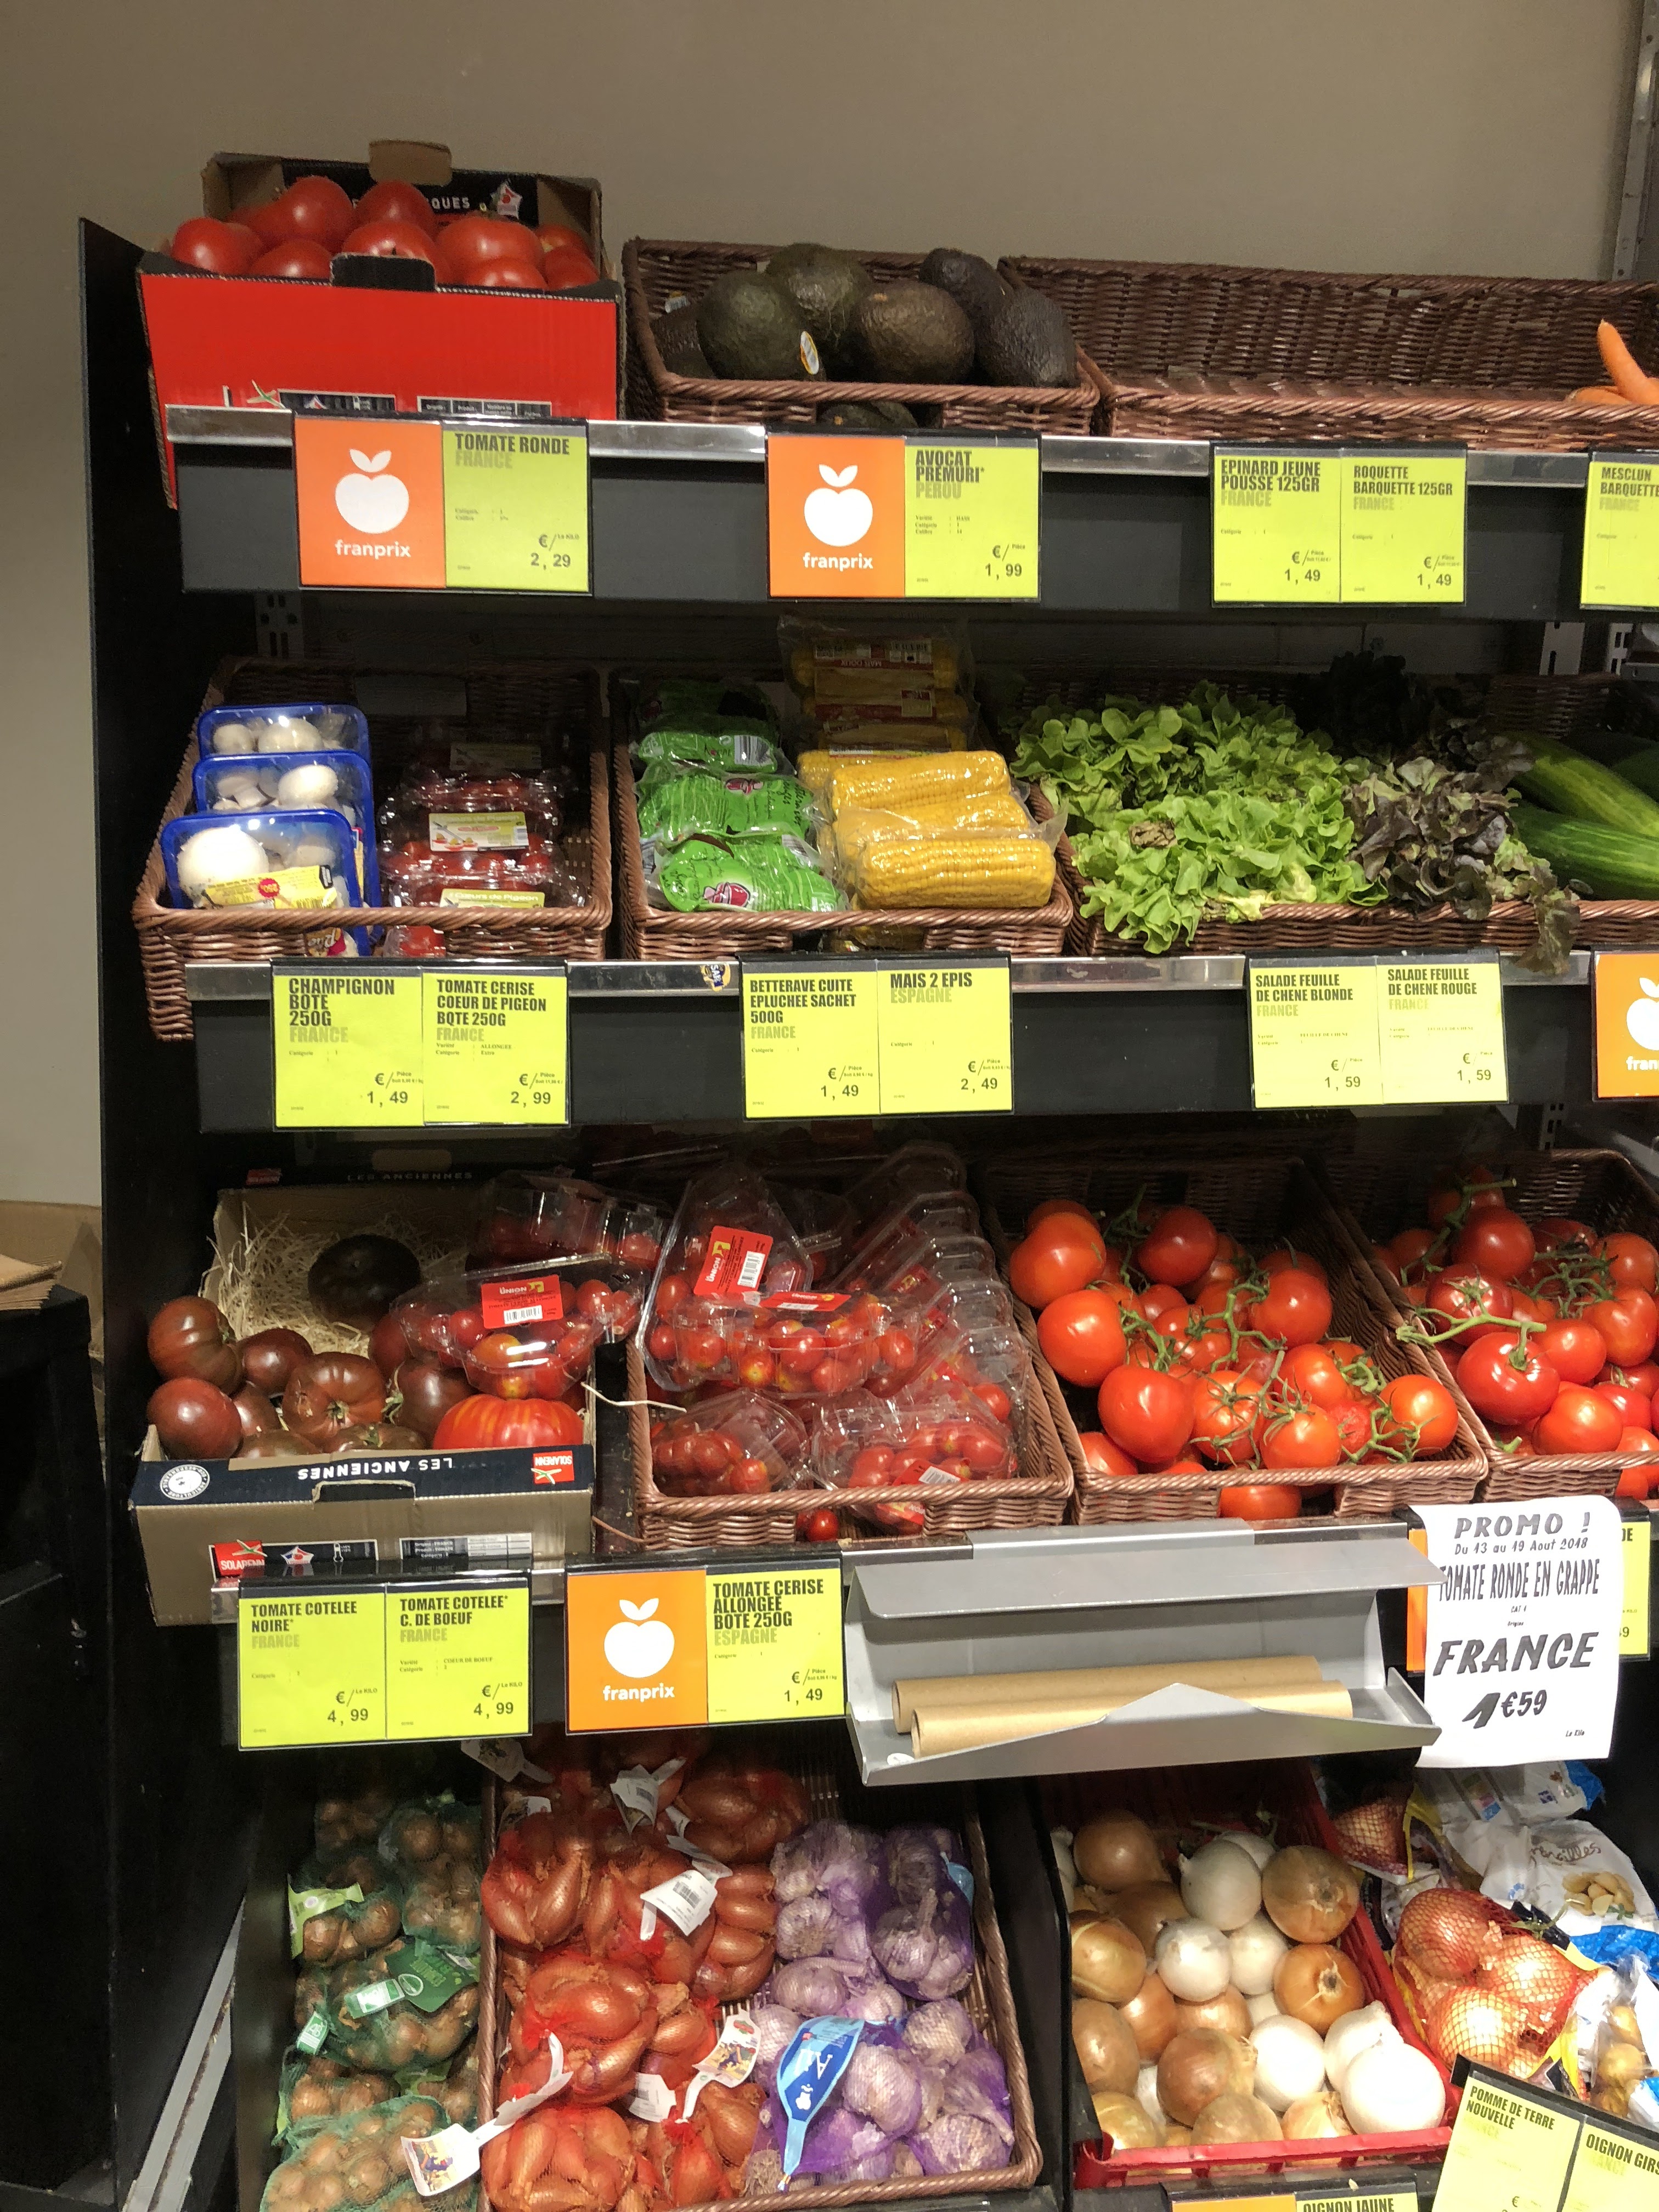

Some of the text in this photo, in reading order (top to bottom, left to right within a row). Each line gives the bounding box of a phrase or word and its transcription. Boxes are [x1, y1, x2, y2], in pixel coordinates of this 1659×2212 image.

[455, 433, 570, 455] TOMATE RONDE
[455, 449, 512, 470] FRANCE
[915, 450, 973, 466] AVOCAT
[1221, 459, 1321, 477] EPINARD JEUNE
[1353, 465, 1409, 481] ROQUETTE
[1601, 467, 1652, 482] MESCLUN
[915, 481, 962, 500] PEROU
[1221, 475, 1320, 492] POUSSE 125GR
[1353, 481, 1453, 497] BARQUETTE 125GR
[1221, 491, 1272, 507] FRANCE
[1353, 496, 1395, 511] FRANCE
[1599, 496, 1640, 511] FRANCE
[335, 539, 411, 560] franprix
[803, 551, 874, 572] franprix
[890, 972, 973, 989] MAIS 2 EPIS
[1255, 973, 1340, 988] SALADE FEUILLE
[1387, 968, 1470, 981] SALADE FEUILLE
[288, 978, 395, 995] CHAMPIGNON
[437, 979, 535, 996] TOMATE CERISE
[750, 978, 853, 994] BETTERAVE CUITE
[1388, 983, 1477, 996] DE CHENE ROUGE
[289, 994, 329, 1010] BOTE
[750, 994, 857, 1009] EPLUCHEE SACHET
[890, 987, 952, 1004] ESPAGNE
[1256, 988, 1354, 1002] DE CHENE BLONDE
[437, 995, 546, 1012] COEUR DE PIGEON
[1256, 1003, 1299, 1017] FRANCE
[1389, 998, 1430, 1011] FRANCE
[289, 1010, 331, 1026] 250G
[437, 1011, 506, 1026] BQTE 250G
[750, 1009, 784, 1024] 500G
[289, 1026, 349, 1043] FRANCE
[437, 1027, 484, 1042] FRANCE
[751, 1025, 796, 1040] FRANCE
[1626, 1056, 1659, 1071] fran
[297, 1457, 453, 1481] LES ANCIENNES
[1454, 1511, 1590, 1539] PROMO !
[1454, 1537, 1588, 1555] Du 13 au 19 Aout 2018
[1439, 1558, 1600, 1602] TOMATE RONDE EN GRAPPE
[713, 1578, 824, 1599] TOMATE CERISE
[251, 1601, 358, 1617] TOMATE COTELEE
[400, 1597, 449, 1612] TOMATE
[713, 1595, 782, 1614] ALLONGEE
[1510, 1605, 1521, 1614] CAT
[400, 1612, 473, 1627] C. DE BOEUF
[714, 1610, 793, 1630] BOTE 250G
[251, 1634, 300, 1649] FRANCE
[400, 1628, 448, 1643] FRANCE
[714, 1627, 777, 1646] ESPAGNE
[1432, 1631, 1600, 1677] FRANCE
[602, 1682, 675, 1702] franprix
[1461, 1689, 1548, 1729] 1€59
[1470, 2085, 1555, 2130] POMME DE TERRE
[1465, 2101, 1516, 2132] NOUVELLE
[1585, 2134, 1633, 2164] OIGNON
[1303, 2198, 1395, 2212] OIGNON JAUNE
